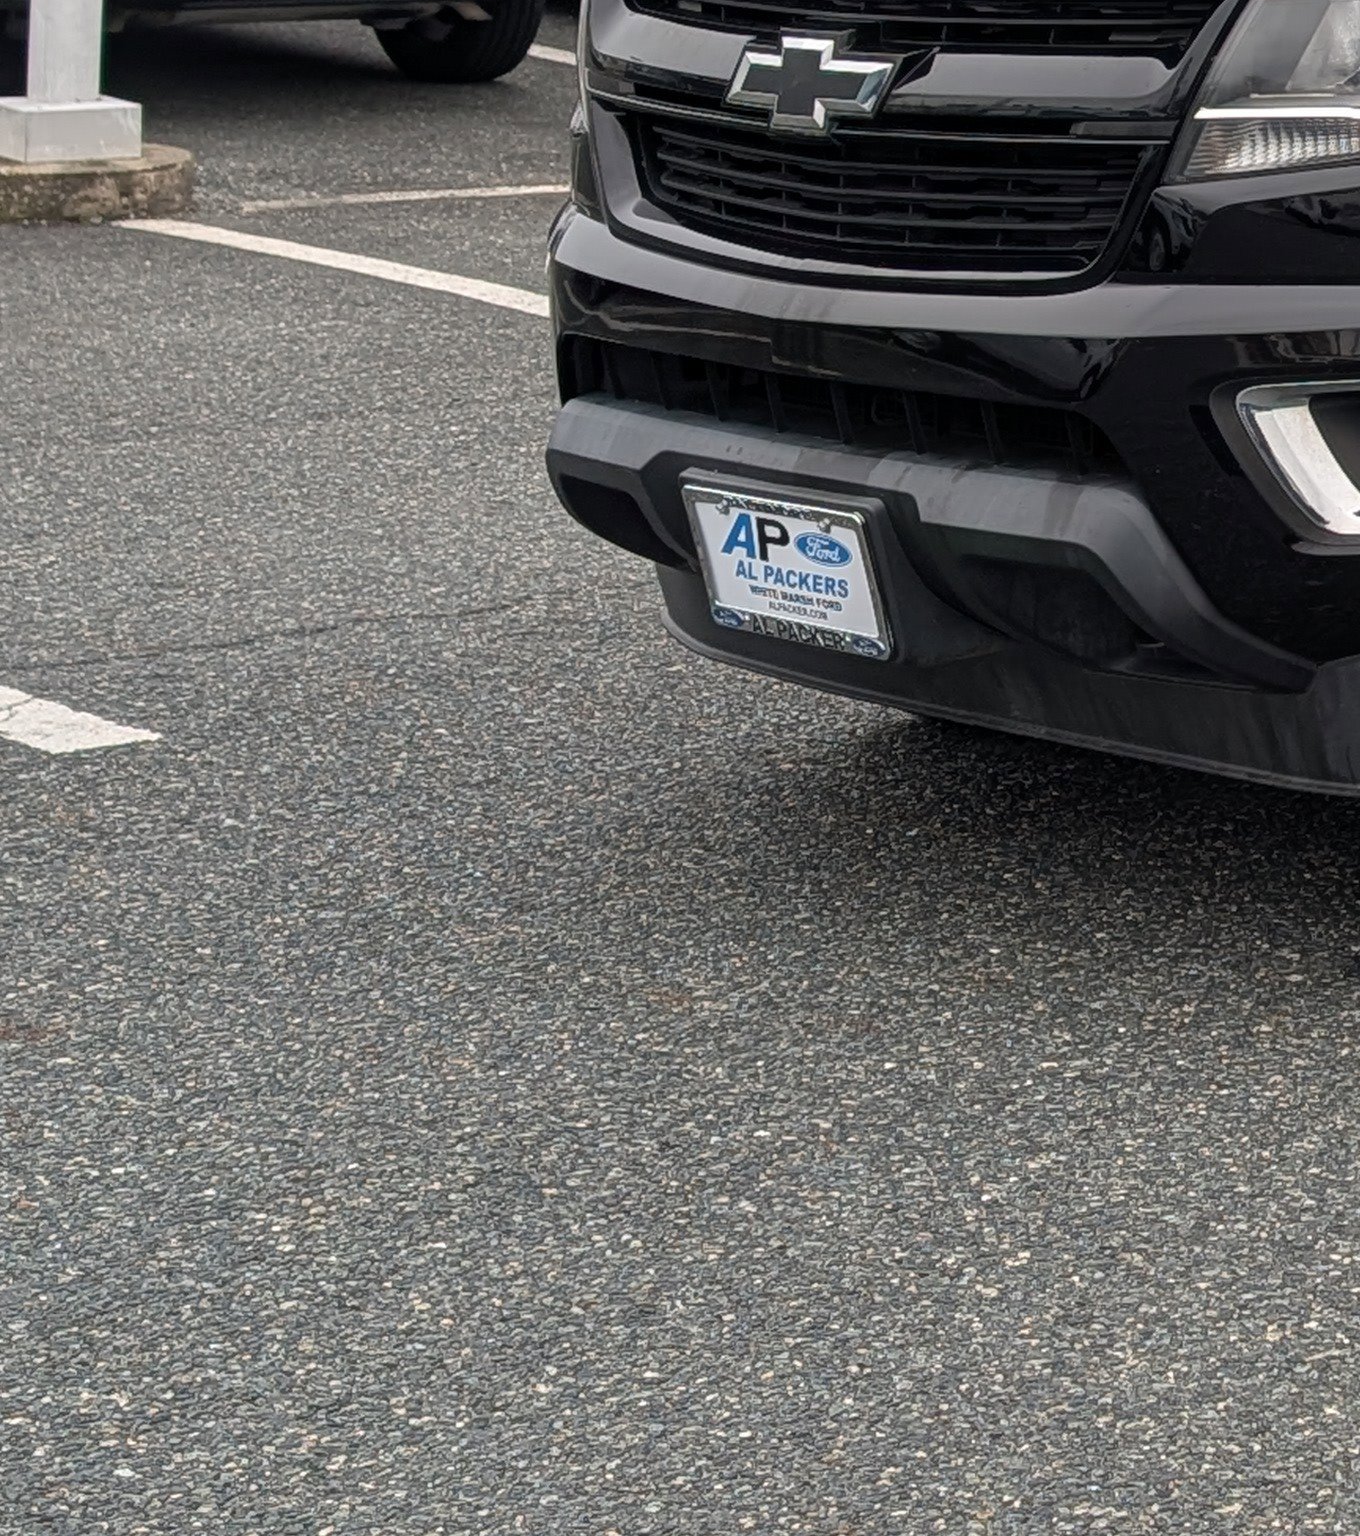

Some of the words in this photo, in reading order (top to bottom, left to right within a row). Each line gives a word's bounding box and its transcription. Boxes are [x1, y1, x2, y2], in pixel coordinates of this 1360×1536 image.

[721, 512, 790, 562] AP
[807, 536, 841, 563] Ford
[735, 560, 758, 581] AL
[763, 564, 849, 599] PACKERS
[749, 584, 779, 601] WHITE
[817, 597, 842, 612] FORD
[752, 613, 773, 634] AL
[778, 620, 846, 650] PACKER
